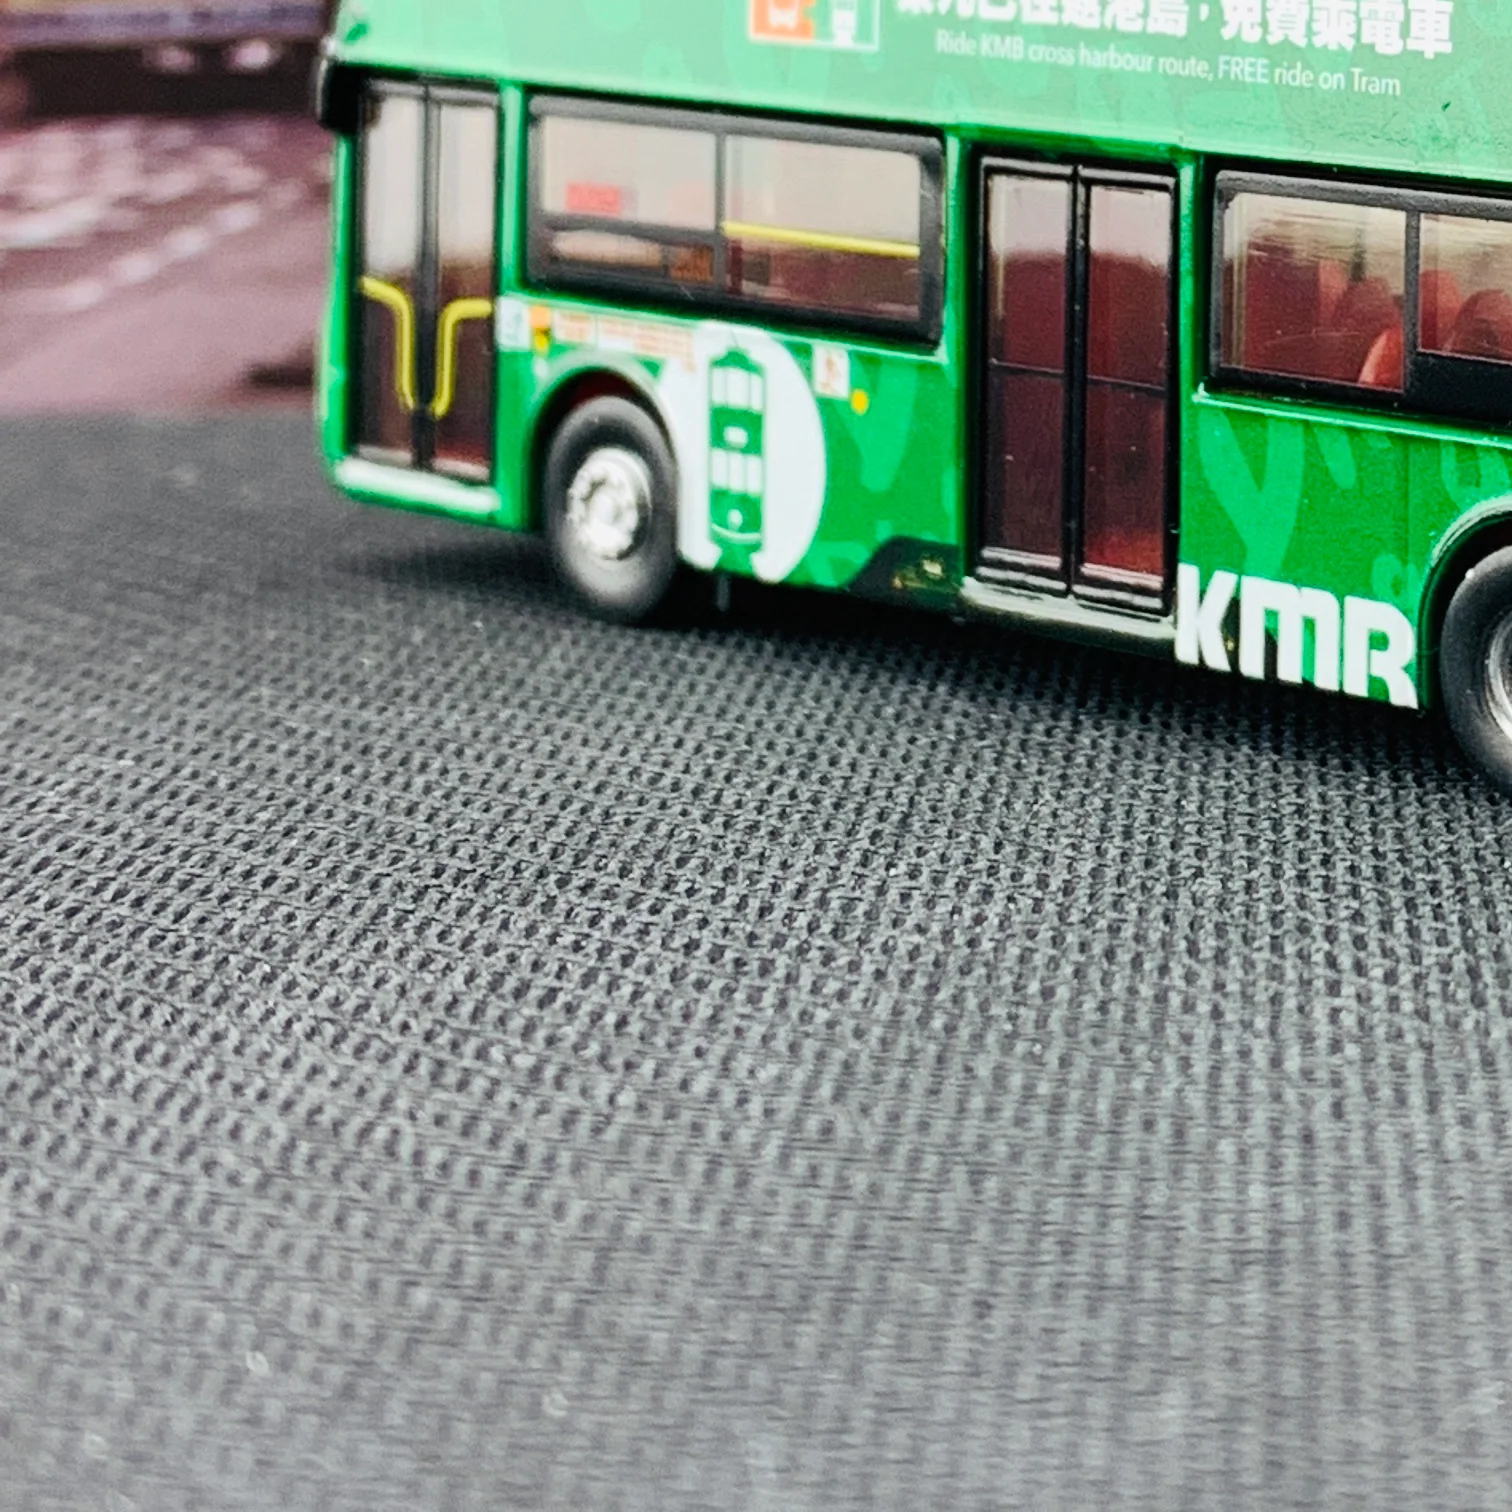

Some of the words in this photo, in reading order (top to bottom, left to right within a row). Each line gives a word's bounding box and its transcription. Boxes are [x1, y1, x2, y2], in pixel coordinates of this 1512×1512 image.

[936, 29, 978, 56] Ride
[980, 34, 1025, 60] KMB
[1028, 42, 1076, 66] cross
[1079, 41, 1155, 73] harbour
[1158, 54, 1213, 81] route,
[1218, 55, 1269, 84] FREE
[1274, 62, 1314, 88] ride
[1318, 71, 1346, 91] on
[1351, 67, 1401, 96] Tram
